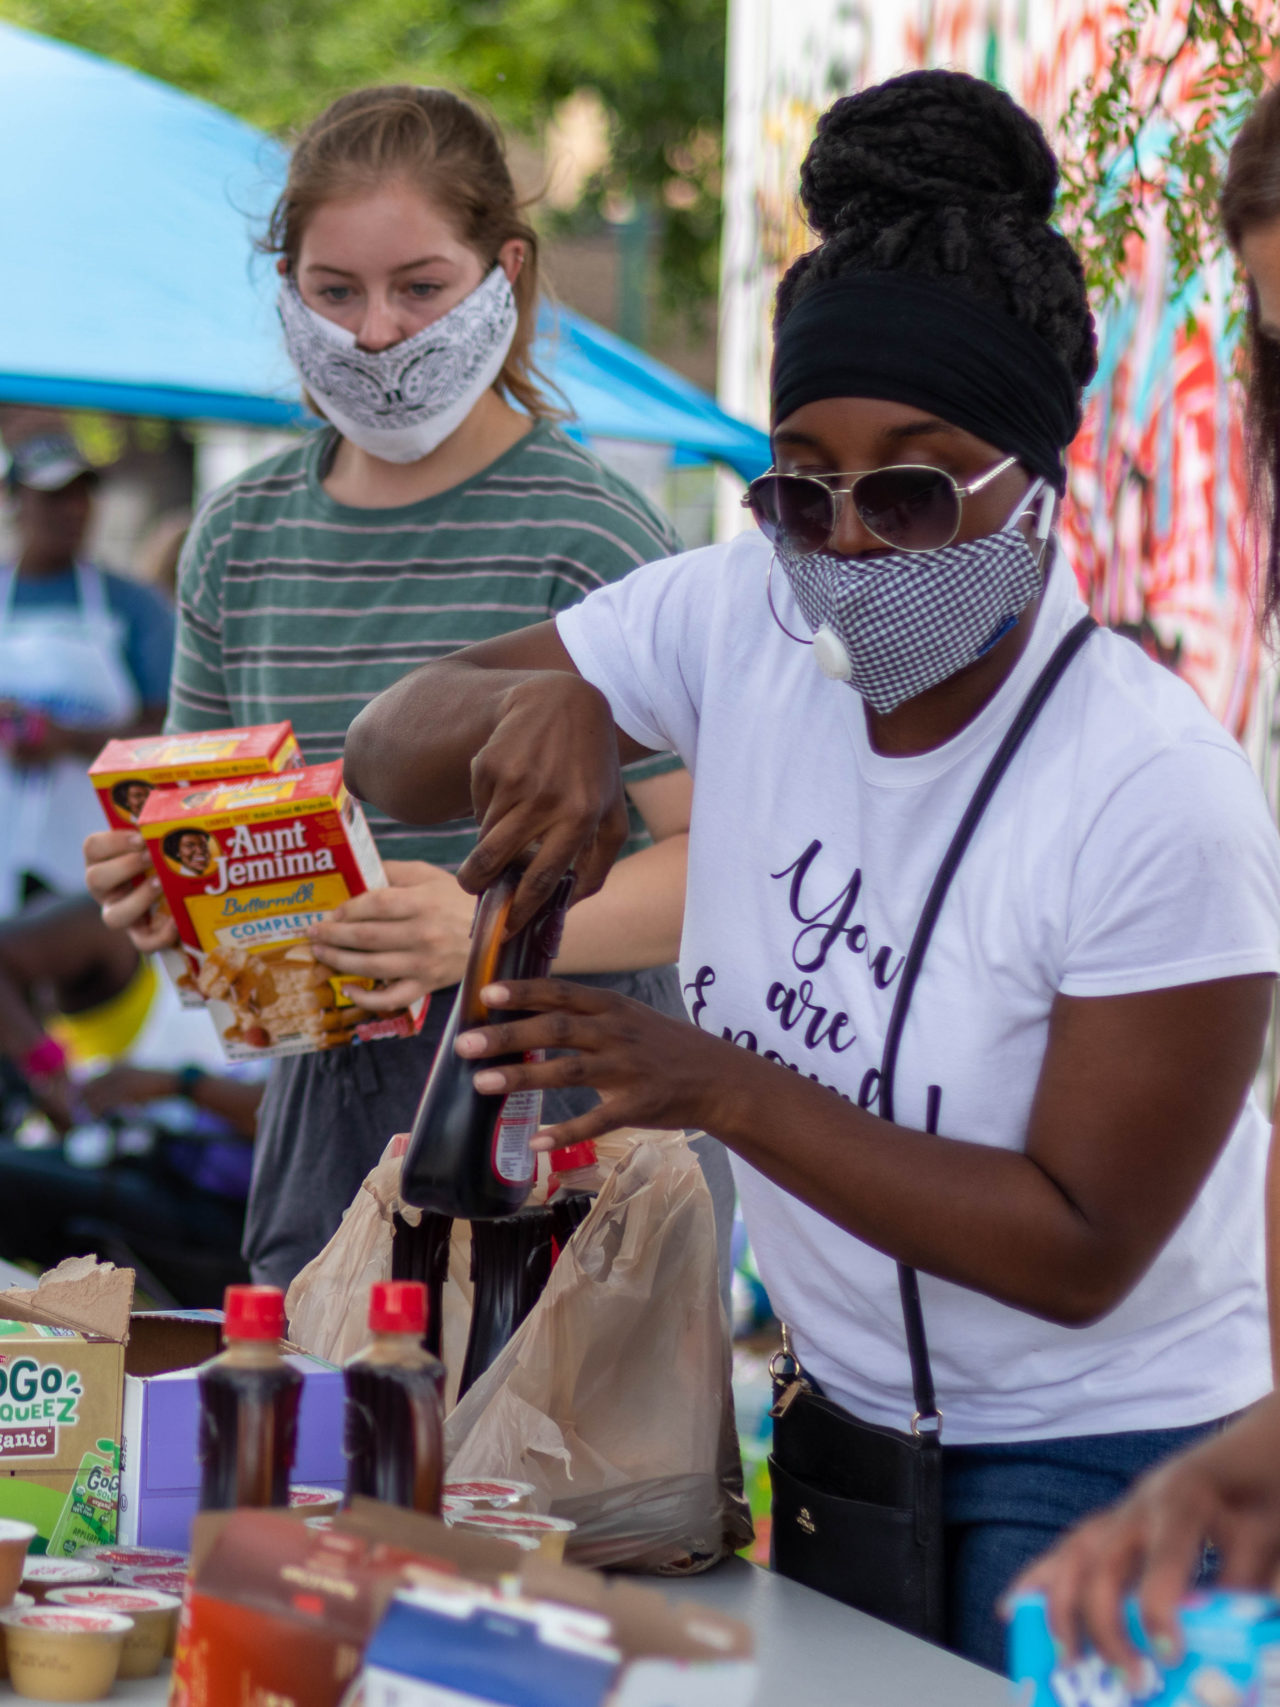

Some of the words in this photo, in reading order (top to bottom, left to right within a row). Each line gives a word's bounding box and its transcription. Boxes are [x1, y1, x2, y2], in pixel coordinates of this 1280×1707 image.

[226, 820, 308, 858] Aunt
[204, 847, 336, 895] Jemima
[222, 882, 315, 917] Buttermilk
[770, 839, 906, 990] You
[765, 979, 857, 1054] are
